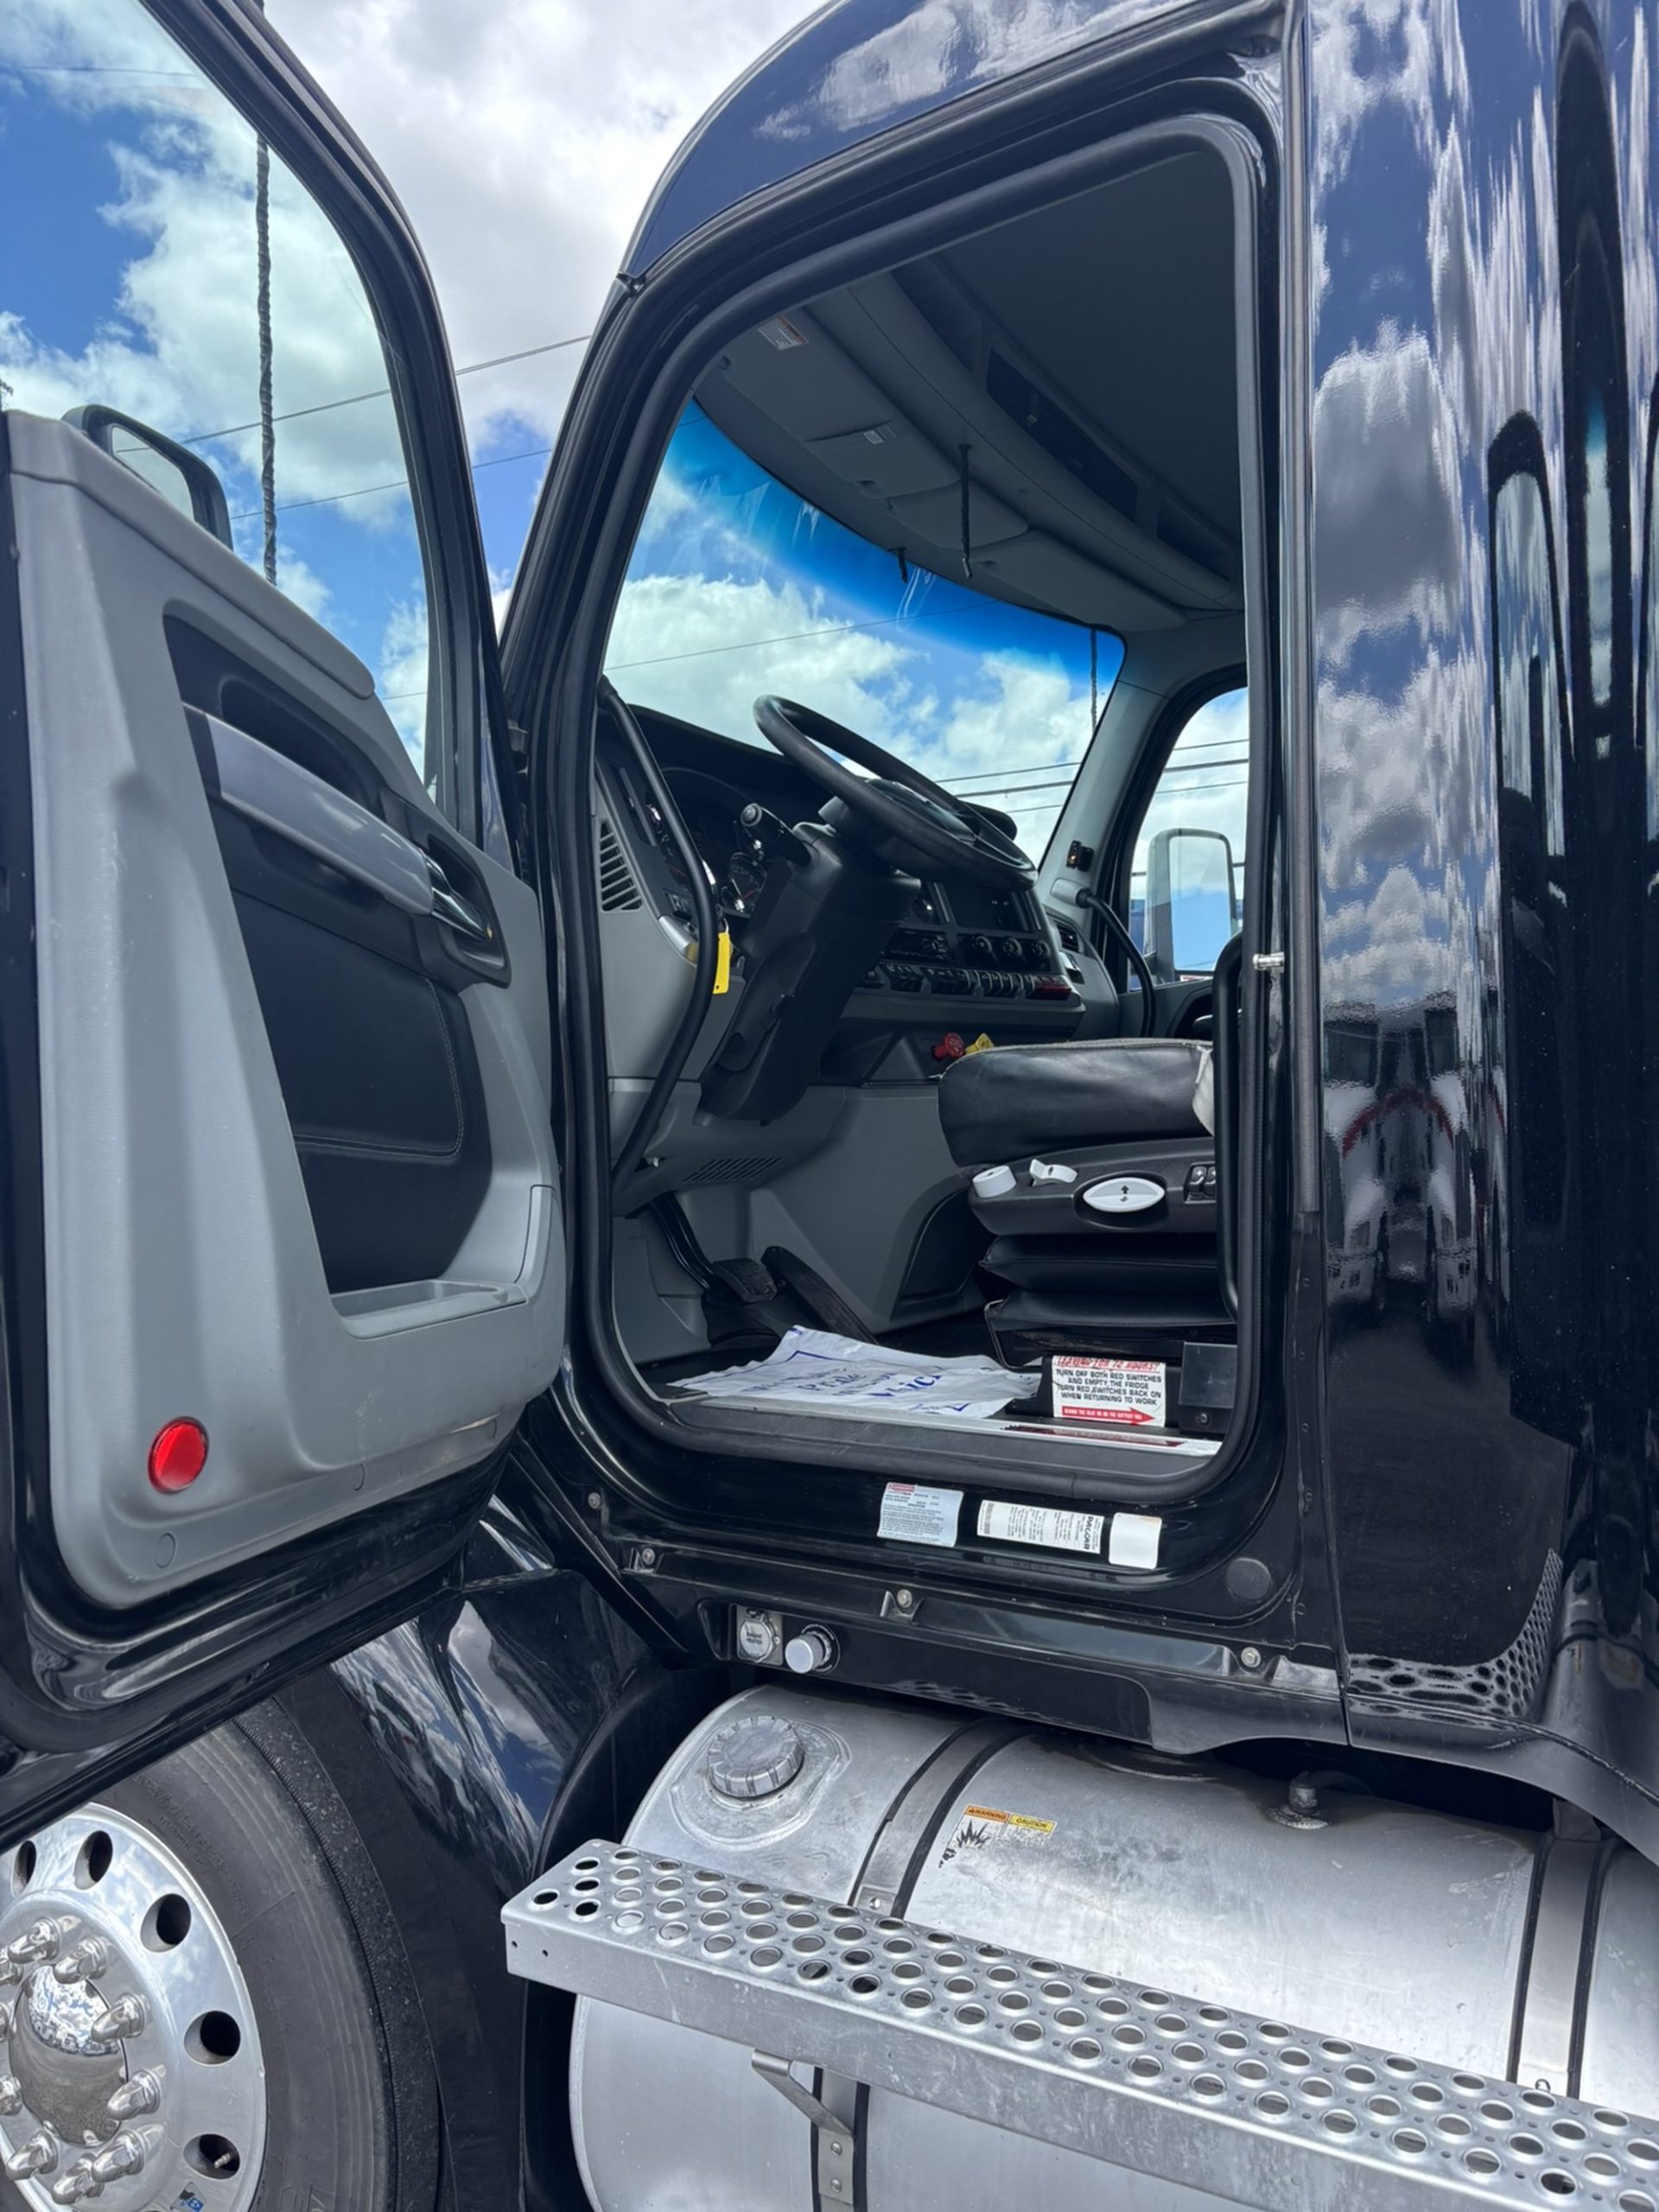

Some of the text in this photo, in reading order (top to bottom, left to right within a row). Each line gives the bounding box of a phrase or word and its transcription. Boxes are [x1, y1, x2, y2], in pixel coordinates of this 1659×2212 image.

[1126, 1373, 1161, 1382] SWITCHES
[1091, 1386, 1127, 1395] SWITCHES
[1128, 1389, 1148, 1397] BACK
[1084, 1393, 1122, 1402] RETURNING
[1084, 1516, 1094, 1550] PACCAR
[975, 1808, 1007, 1820] WARNING
[1016, 1817, 1046, 1828] CAUTION
